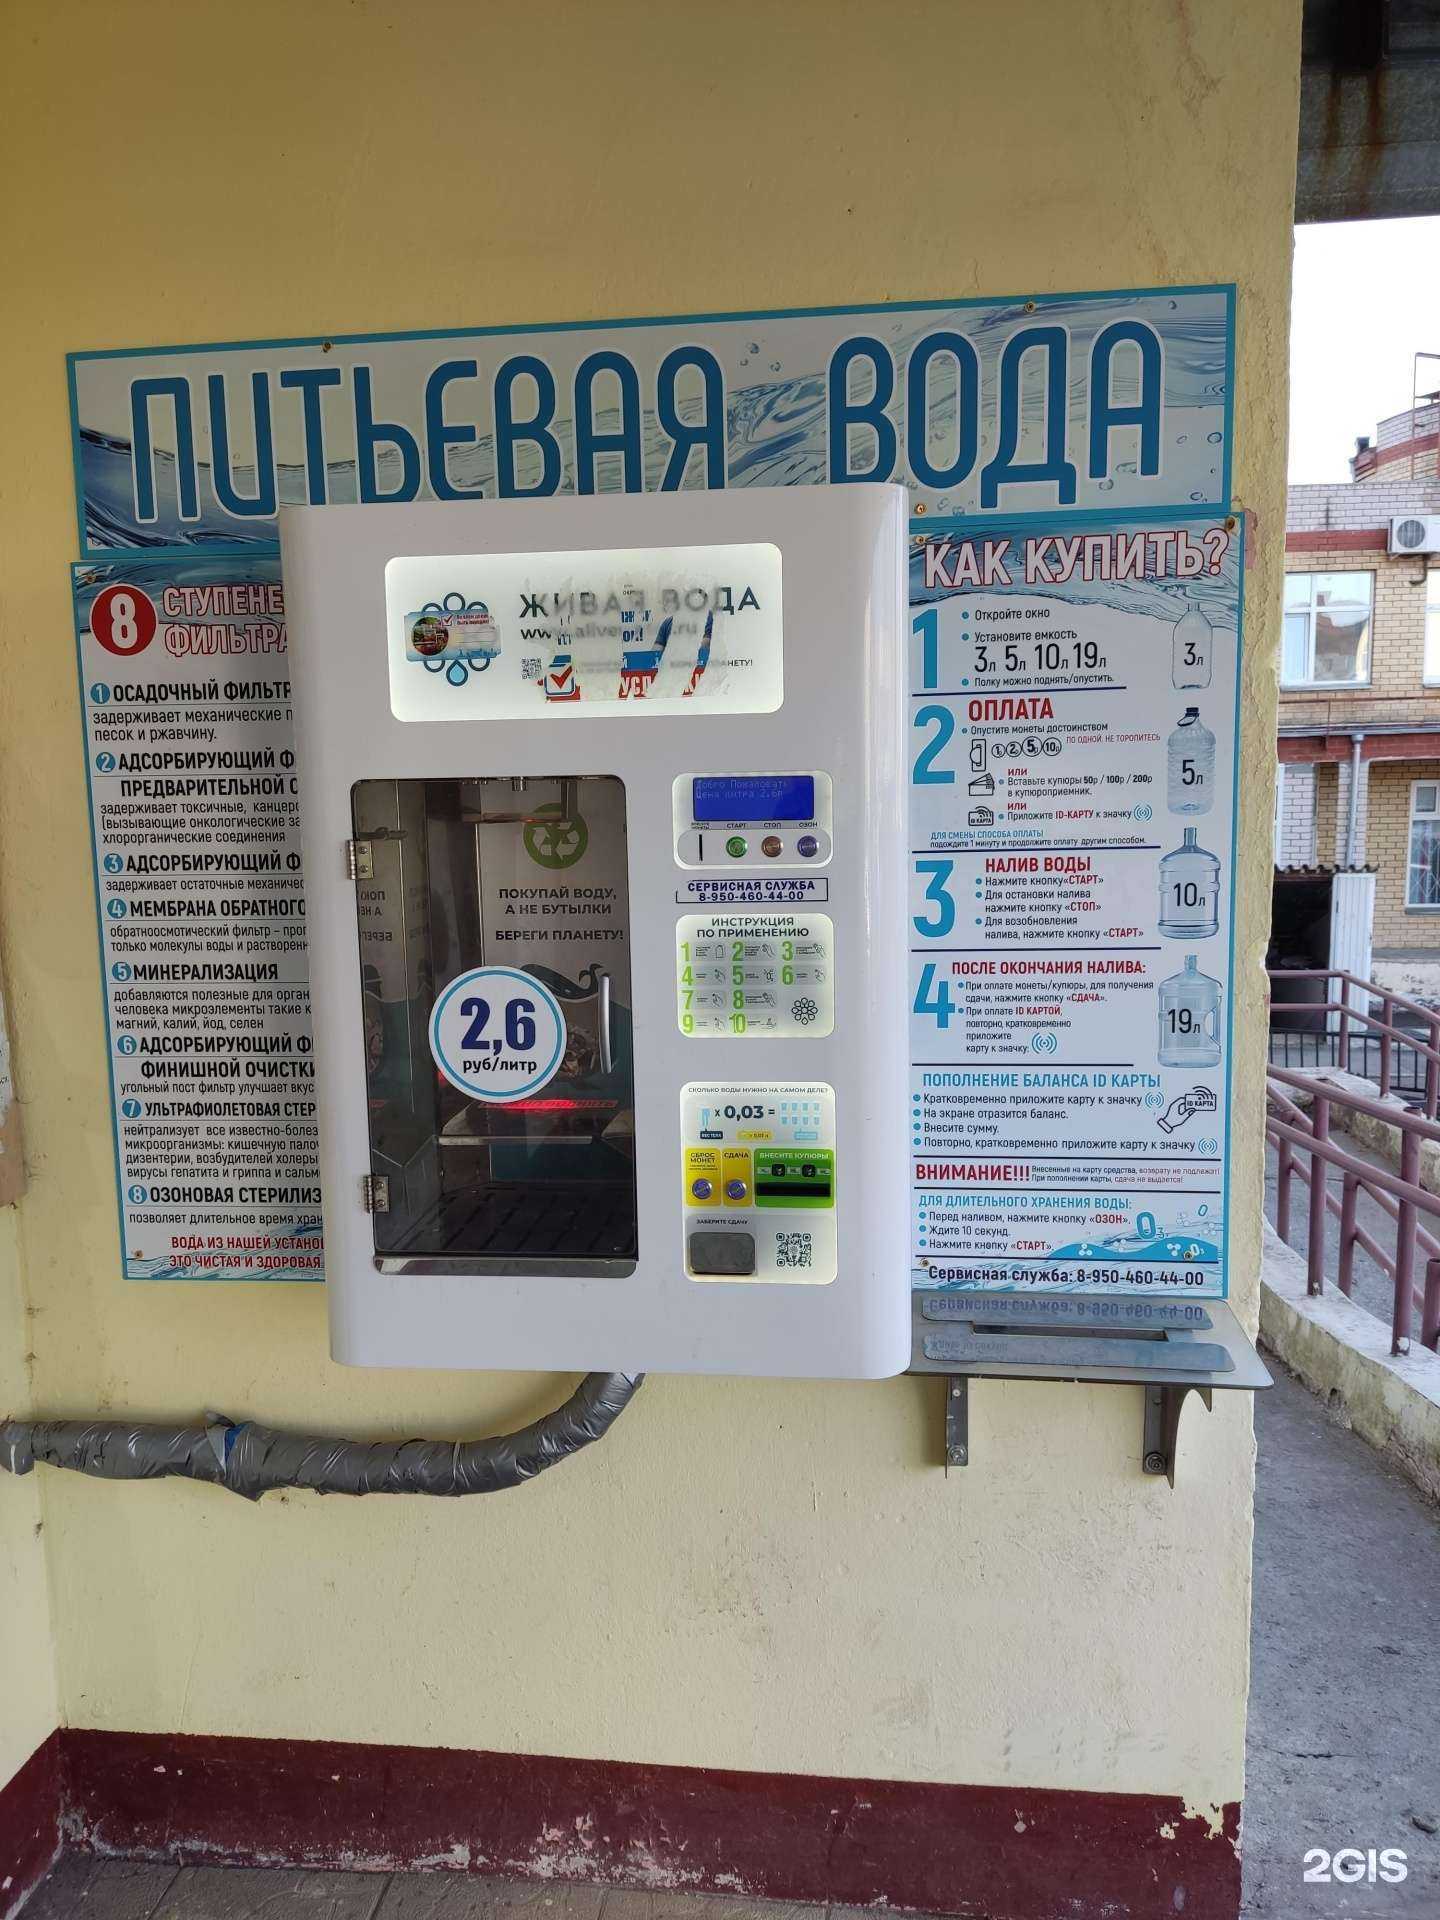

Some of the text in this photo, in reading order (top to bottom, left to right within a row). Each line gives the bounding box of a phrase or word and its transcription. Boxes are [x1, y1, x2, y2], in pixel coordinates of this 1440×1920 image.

[828, 320, 1162, 508] ВОДА
[924, 528, 1229, 589] КАК КУПИТЬ?
[110, 593, 137, 649] 8
[975, 609, 1050, 621] Откройте окно
[975, 629, 1077, 643] Установите емкость
[912, 609, 937, 688] 1
[974, 641, 1106, 672] 3л 5л 10л 19л
[974, 673, 1114, 688] Полку можно поднять/опустить.
[113, 679, 219, 704] ОСАДОЧНЫЙ
[93, 711, 181, 726] задерживает
[185, 709, 281, 723] механические
[968, 697, 1054, 722] ОПЛАТА
[95, 728, 217, 743] песок и ржавчину.
[971, 722, 1108, 736] Опустите монеты достоинством
[912, 704, 955, 785] 2
[119, 747, 275, 773] АДСОРБИРУЮЩИЙ
[121, 775, 284, 799] ПРЕДВАРИТЕЛЬНОЙ
[986, 856, 1090, 873] НАЛИВ ВОДЫ
[499, 887, 616, 900] ПОКУПАЙ ВОДУ,
[688, 881, 815, 892] СЕРВИСНАЯ СЛУЖБА
[985, 889, 1090, 900] Для остановки налива
[699, 891, 804, 901] 8-950-460-44-00
[913, 860, 955, 937] 3
[131, 900, 216, 917] МЕМБРАНА
[505, 904, 612, 915] А НЕ БУТЫЛКИ
[986, 901, 1101, 914] нажмите кнопку «СТОП»
[712, 917, 794, 928] ИНСТРУКЦИЯ
[111, 924, 270, 938] обратноосмотический фильтр
[495, 930, 623, 940] БЕРЕГИ ПЛАНЕТУ!
[697, 928, 809, 938] ПО ПРИМЕНЕНИЮ
[112, 940, 243, 952] только молекулы воды и
[681, 942, 691, 961] 1
[731, 942, 744, 961] 2
[782, 941, 793, 961] 3
[134, 964, 278, 982] МИНЕРАЛИЗАЦИЯ
[681, 966, 793, 985] 4 5 6
[952, 960, 1146, 975] ПОСЛЕ ОКОНЧАНИЯ НАЛИВА:
[114, 989, 273, 1001] добавляются полезные для
[682, 990, 744, 1009] 7 8
[913, 964, 955, 1029] 4
[460, 998, 535, 1056] 2,6
[682, 1013, 746, 1034] 9 10
[141, 1059, 239, 1079] ФИНИШНОЙ
[463, 1058, 537, 1075] руб/литр
[923, 1073, 1160, 1088] ПОПОЛНЕНИЕ БАЛАНСА ID КАРТЫ
[145, 1102, 280, 1117] УЛЬТРАФИОЛЕТОВАЯ
[724, 1105, 764, 1121] 0,03
[924, 1108, 1068, 1119] На экране отразится баланс.
[924, 1123, 999, 1135] Внесите сумму.
[128, 1168, 271, 1180] вирусы гепатита и гриппа
[916, 1164, 1030, 1181] ВНИМАНИЕ!!!
[150, 1187, 233, 1203] ОЗОНОВАЯ
[919, 1195, 1131, 1210] ДЛЯ ДЛИТЕЛЬНОГО ХРАНЕНИЯ ВОДЫ:
[130, 1213, 293, 1226] позволяет длительное время
[929, 1225, 1009, 1238] Ждите 10 секунд.
[172, 1236, 203, 1250] ВОДА
[208, 1237, 223, 1248] ИЗ
[228, 1234, 271, 1249] НАШЕЙ
[169, 1255, 320, 1269] ЭТО ЧИСТАЯ И ЗДОРОВАЯ
[929, 1266, 1203, 1285] Сервисная служба: 8-950-460-44-00
